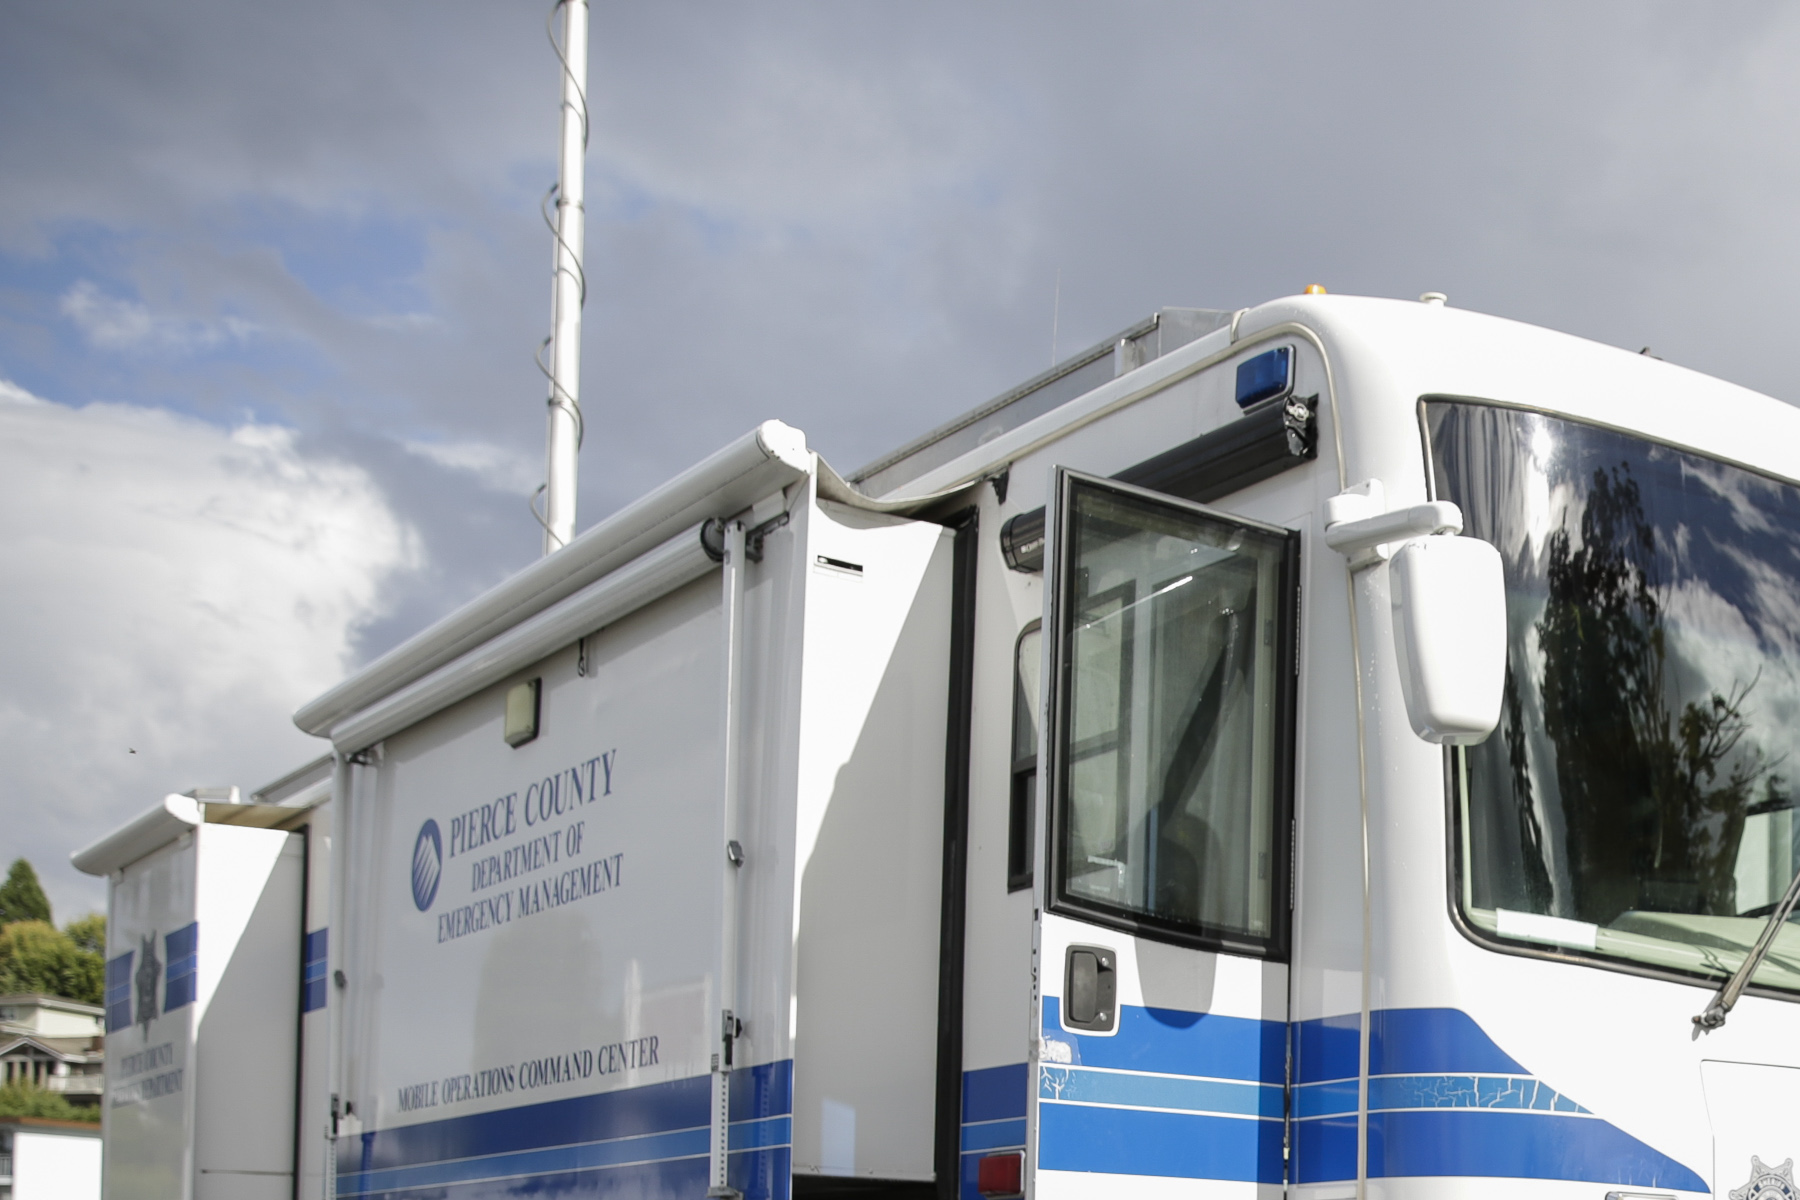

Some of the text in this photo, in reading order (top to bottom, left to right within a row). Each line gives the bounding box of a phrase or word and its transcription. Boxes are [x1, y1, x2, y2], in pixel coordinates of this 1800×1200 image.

[450, 749, 617, 858] PIERCE COUNTY
[437, 853, 623, 944] EMERGENCY MANAGEMENT
[472, 821, 585, 892] DEPARTMENT OF
[397, 1036, 660, 1113] MOBILE OPERATIONS COMMAND CENTER
